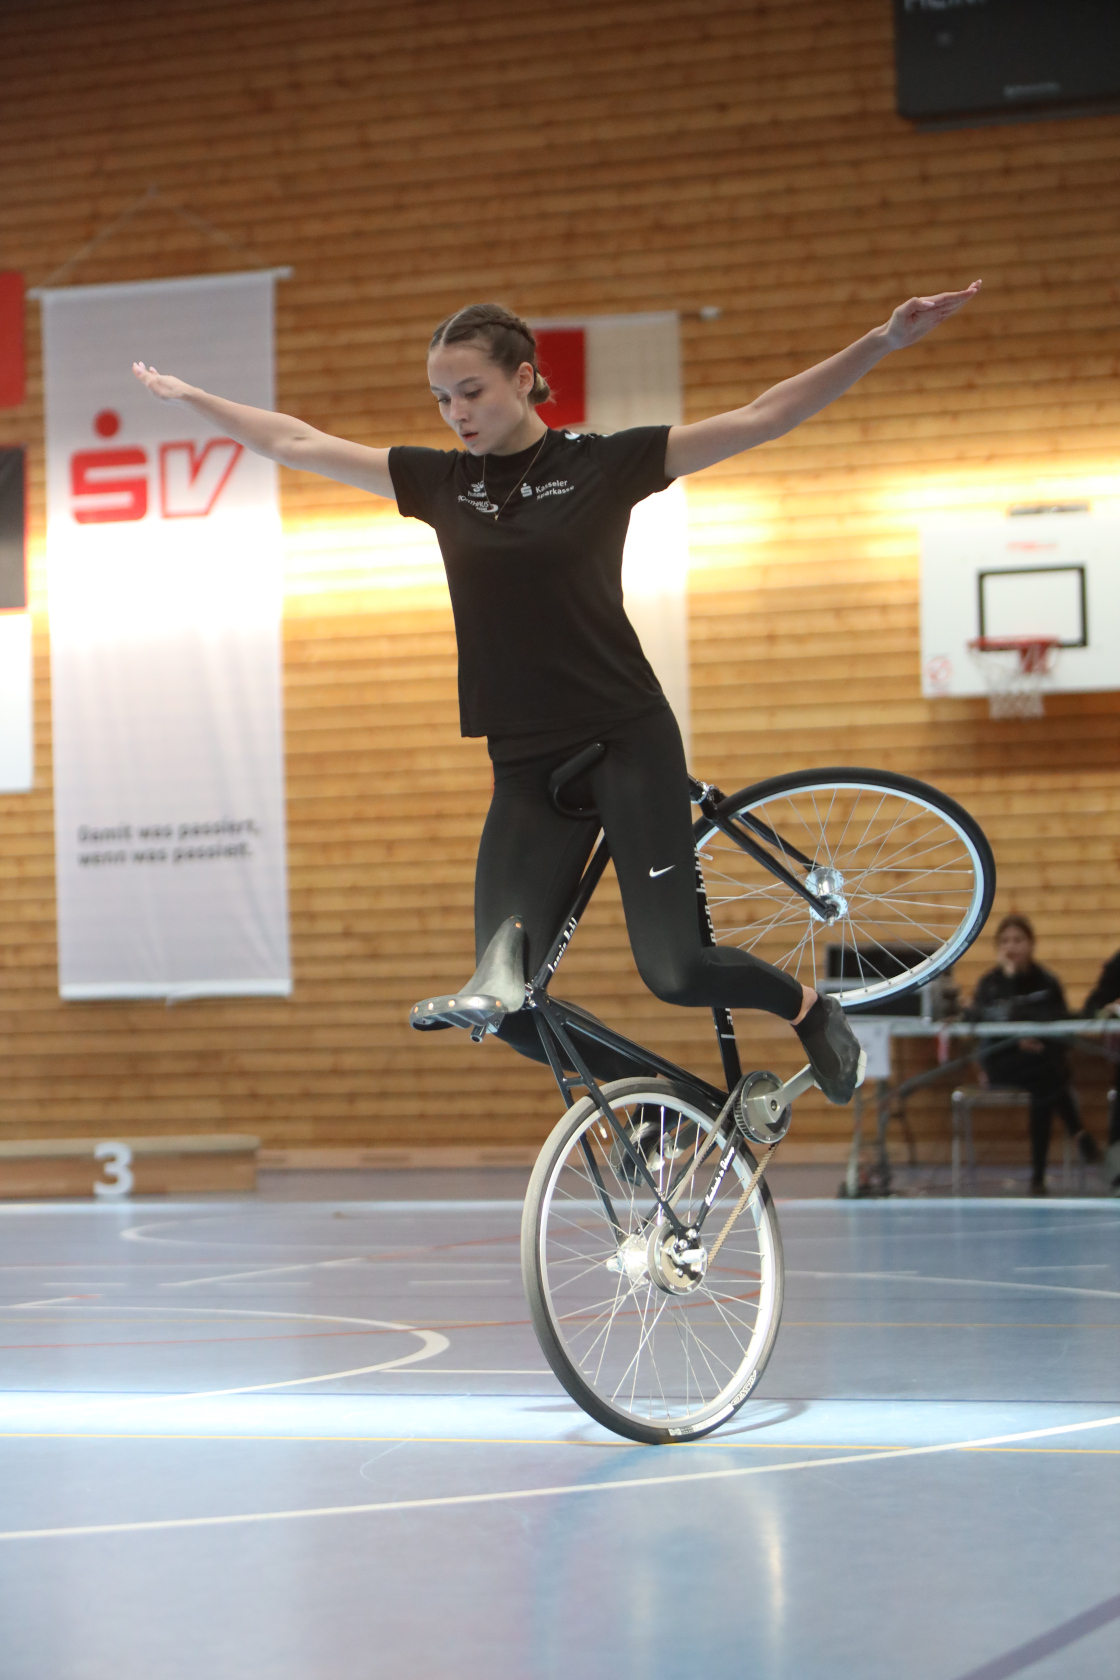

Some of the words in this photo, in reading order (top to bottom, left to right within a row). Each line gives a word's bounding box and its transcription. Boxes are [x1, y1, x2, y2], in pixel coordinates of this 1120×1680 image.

[535, 480, 568, 494] Kasseler
[132, 849, 168, 863] was
[92, 1140, 133, 1194] 3
